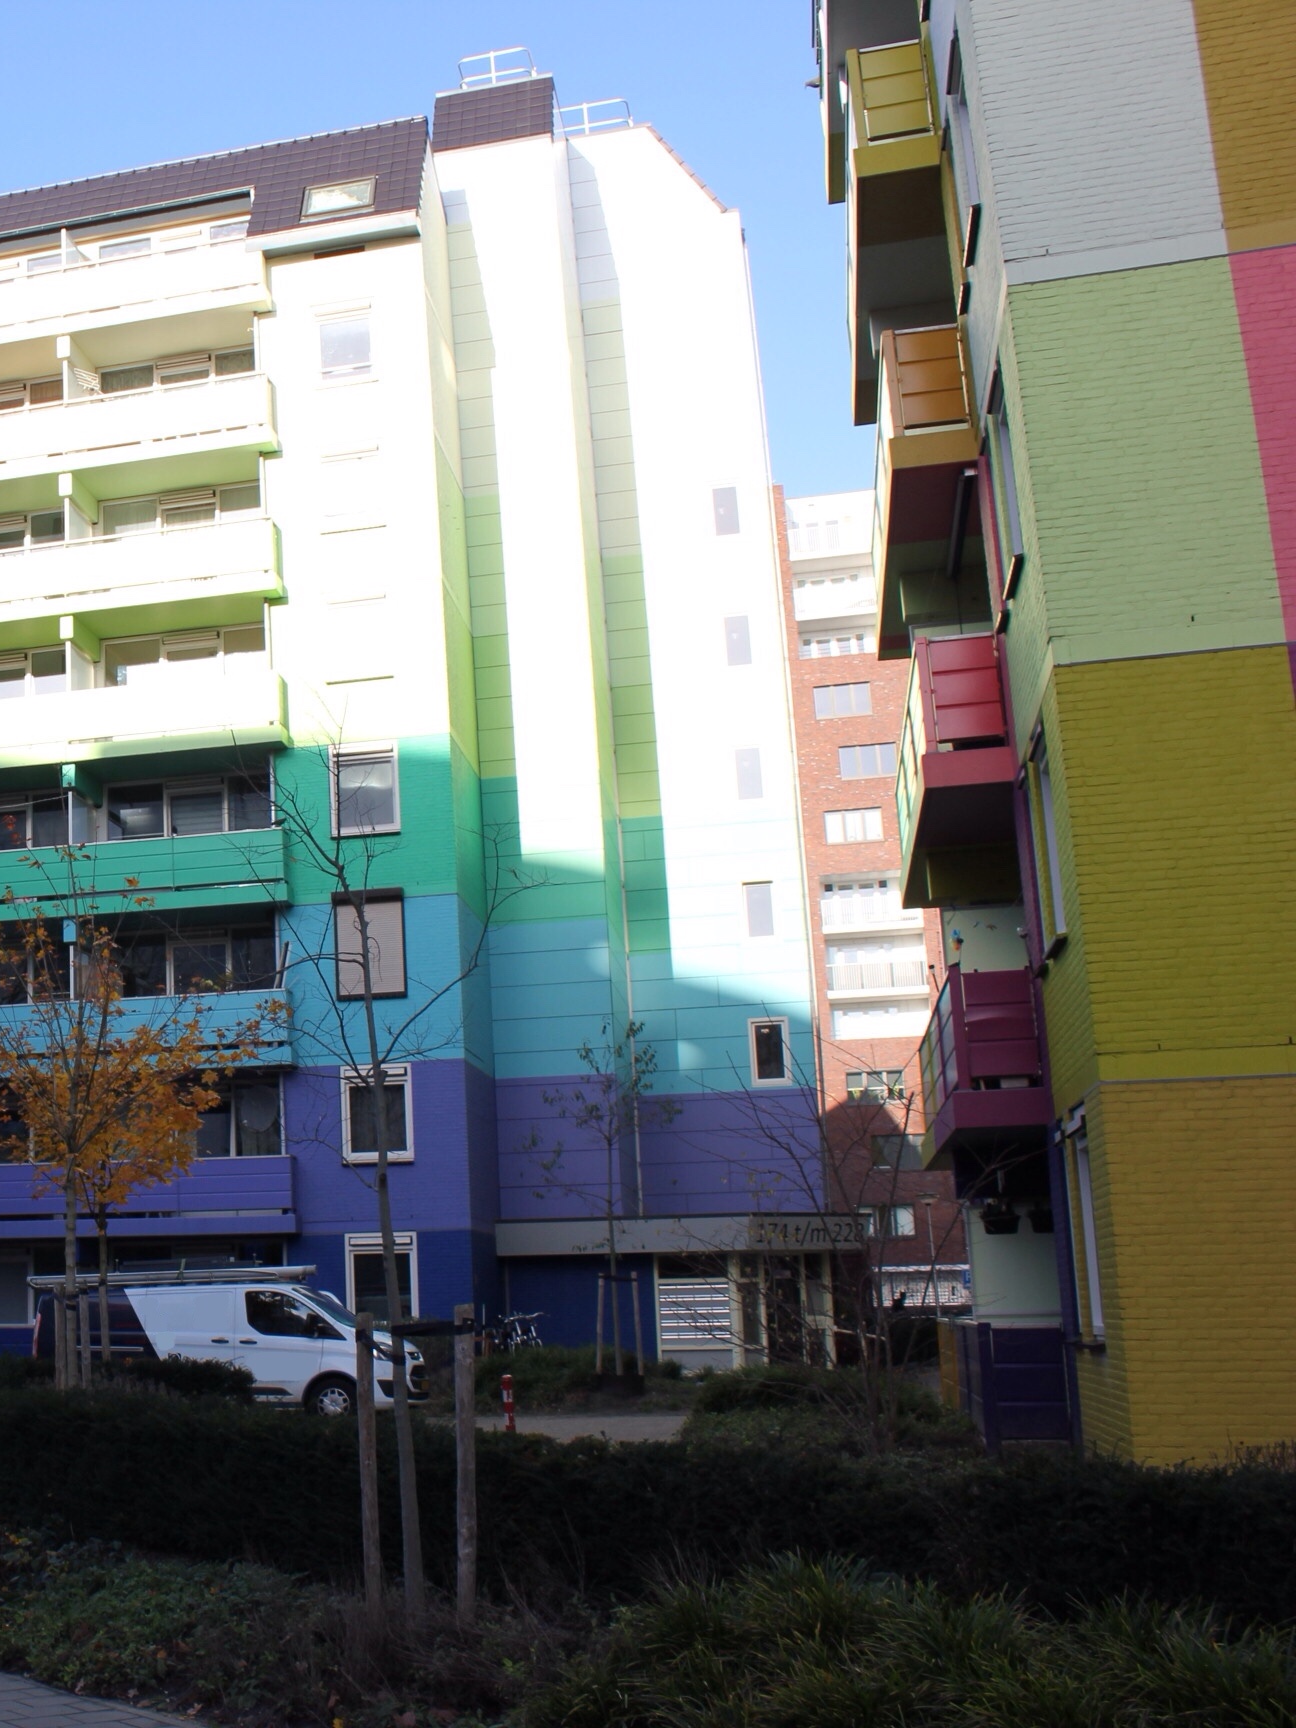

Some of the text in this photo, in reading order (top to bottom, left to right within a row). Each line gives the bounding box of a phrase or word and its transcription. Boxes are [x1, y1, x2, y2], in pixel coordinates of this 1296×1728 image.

[756, 1221, 864, 1246] 174 t/m 228
